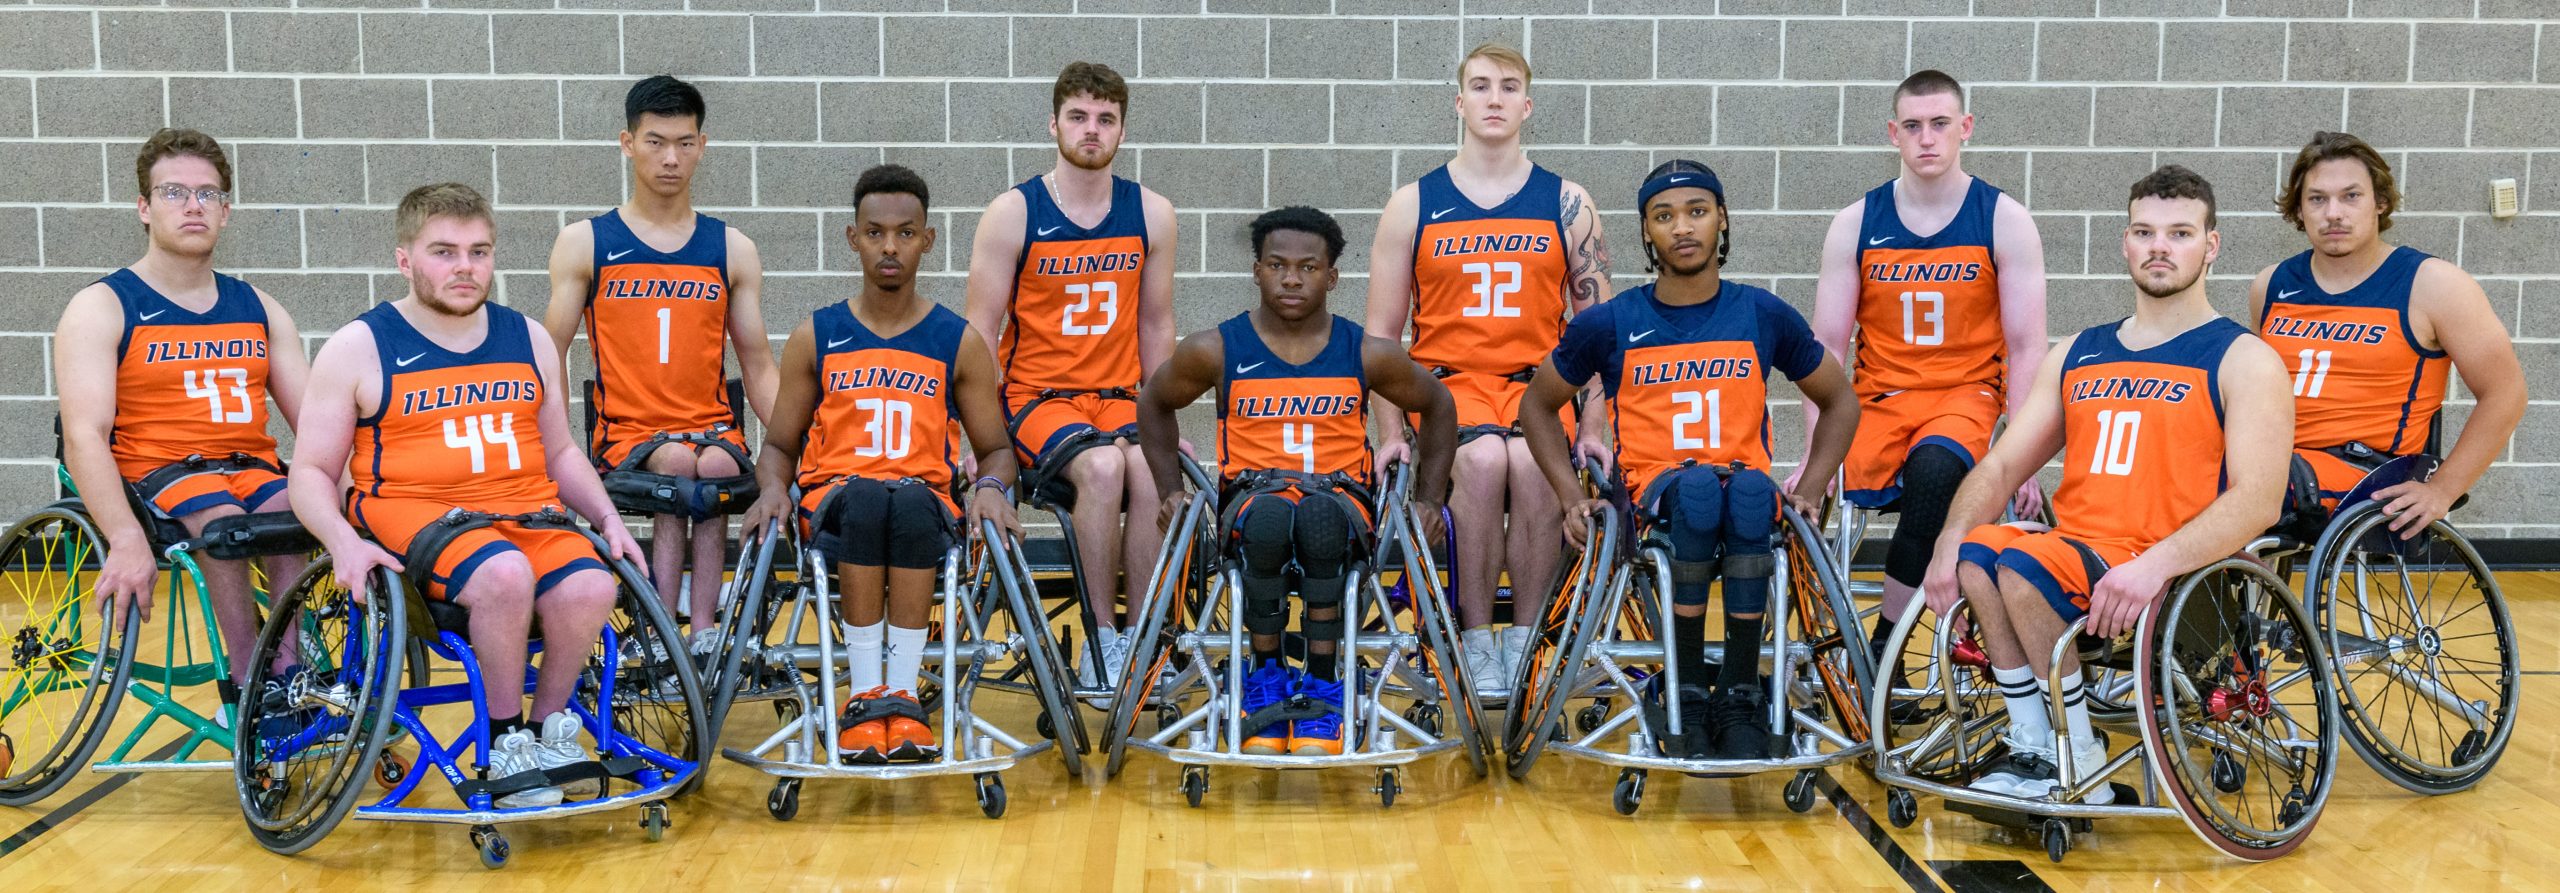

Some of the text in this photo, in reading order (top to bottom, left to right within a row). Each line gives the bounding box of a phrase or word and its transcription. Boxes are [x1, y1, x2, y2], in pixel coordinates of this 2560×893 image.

[1037, 252, 1140, 275] ILLINOIS
[1433, 234, 1551, 257] ILLINOIS
[605, 279, 722, 301] ILLINOIS
[1462, 262, 1522, 317] 32
[1870, 263, 1981, 282] ILLINOIS
[1062, 281, 1117, 335] 23
[1900, 291, 1944, 345] 13
[146, 339, 266, 364] ILLINOIS
[657, 308, 670, 363] 1
[2268, 317, 2388, 345] ILLINOIS
[829, 367, 939, 399] ILLINOIS
[1633, 358, 1753, 385] ILLINOIS
[2070, 377, 2192, 404] ILLINOIS
[2294, 349, 2332, 398] 11
[184, 368, 252, 423] 43
[403, 380, 536, 415] ILLINOIS
[1237, 395, 1359, 417] ILLINOIS
[855, 398, 912, 459] 30
[1672, 389, 1720, 450] 21
[443, 412, 521, 473] 44
[1283, 423, 1314, 474] 4
[2090, 410, 2141, 475] 10
